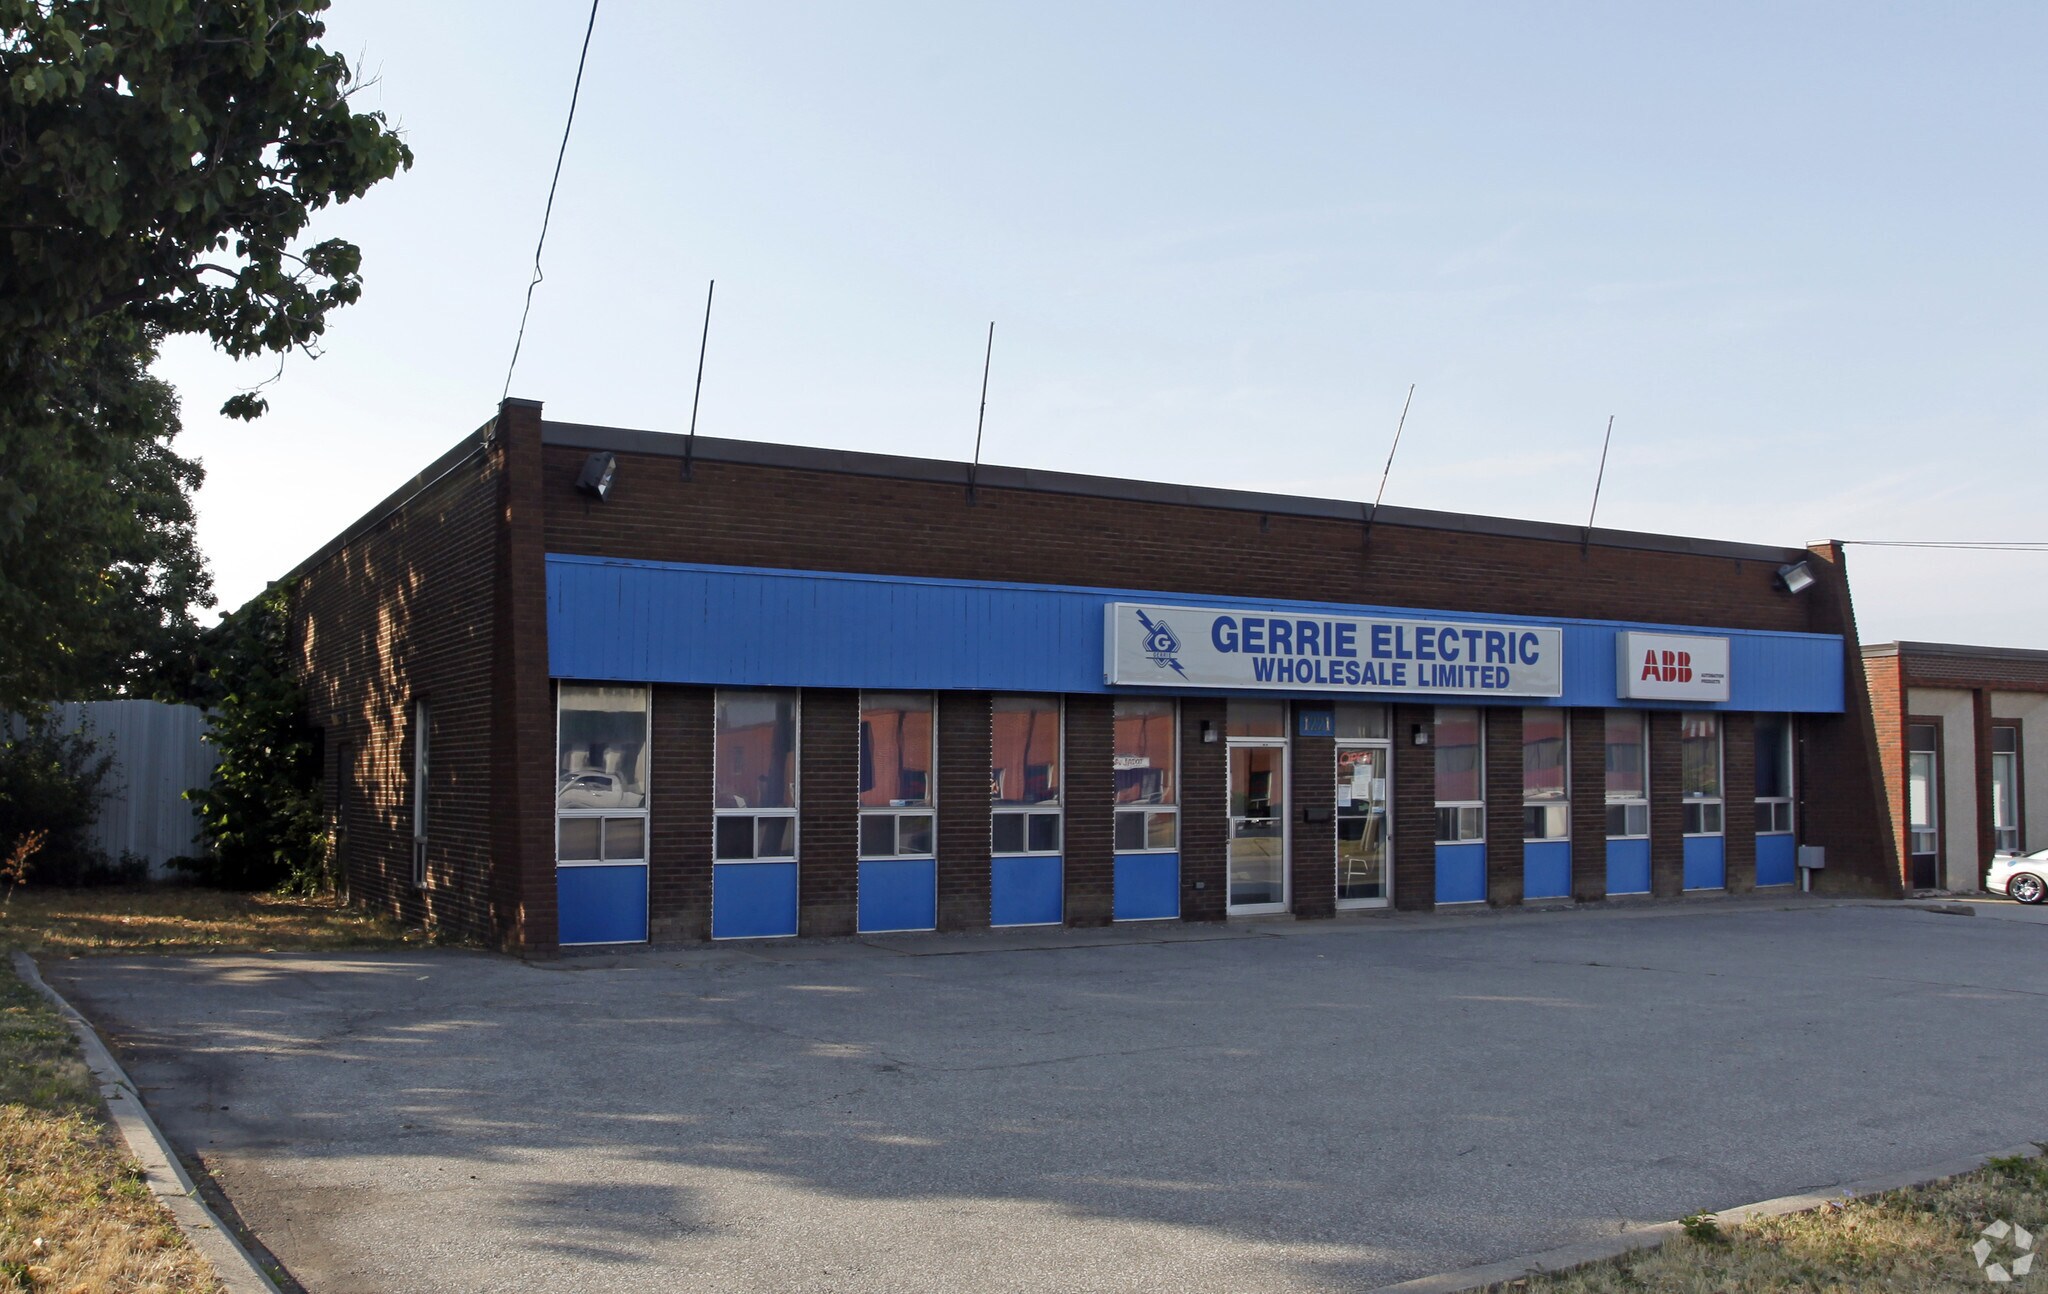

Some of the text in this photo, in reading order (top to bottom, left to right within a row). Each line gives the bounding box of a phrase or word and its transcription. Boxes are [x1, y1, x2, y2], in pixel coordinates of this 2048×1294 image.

[1154, 634, 1171, 651] G
[1211, 616, 1541, 665] GERRIE ELECTRIC
[1252, 657, 1511, 689] WHOLESALE LIMITED
[1641, 650, 1692, 682] ABB
